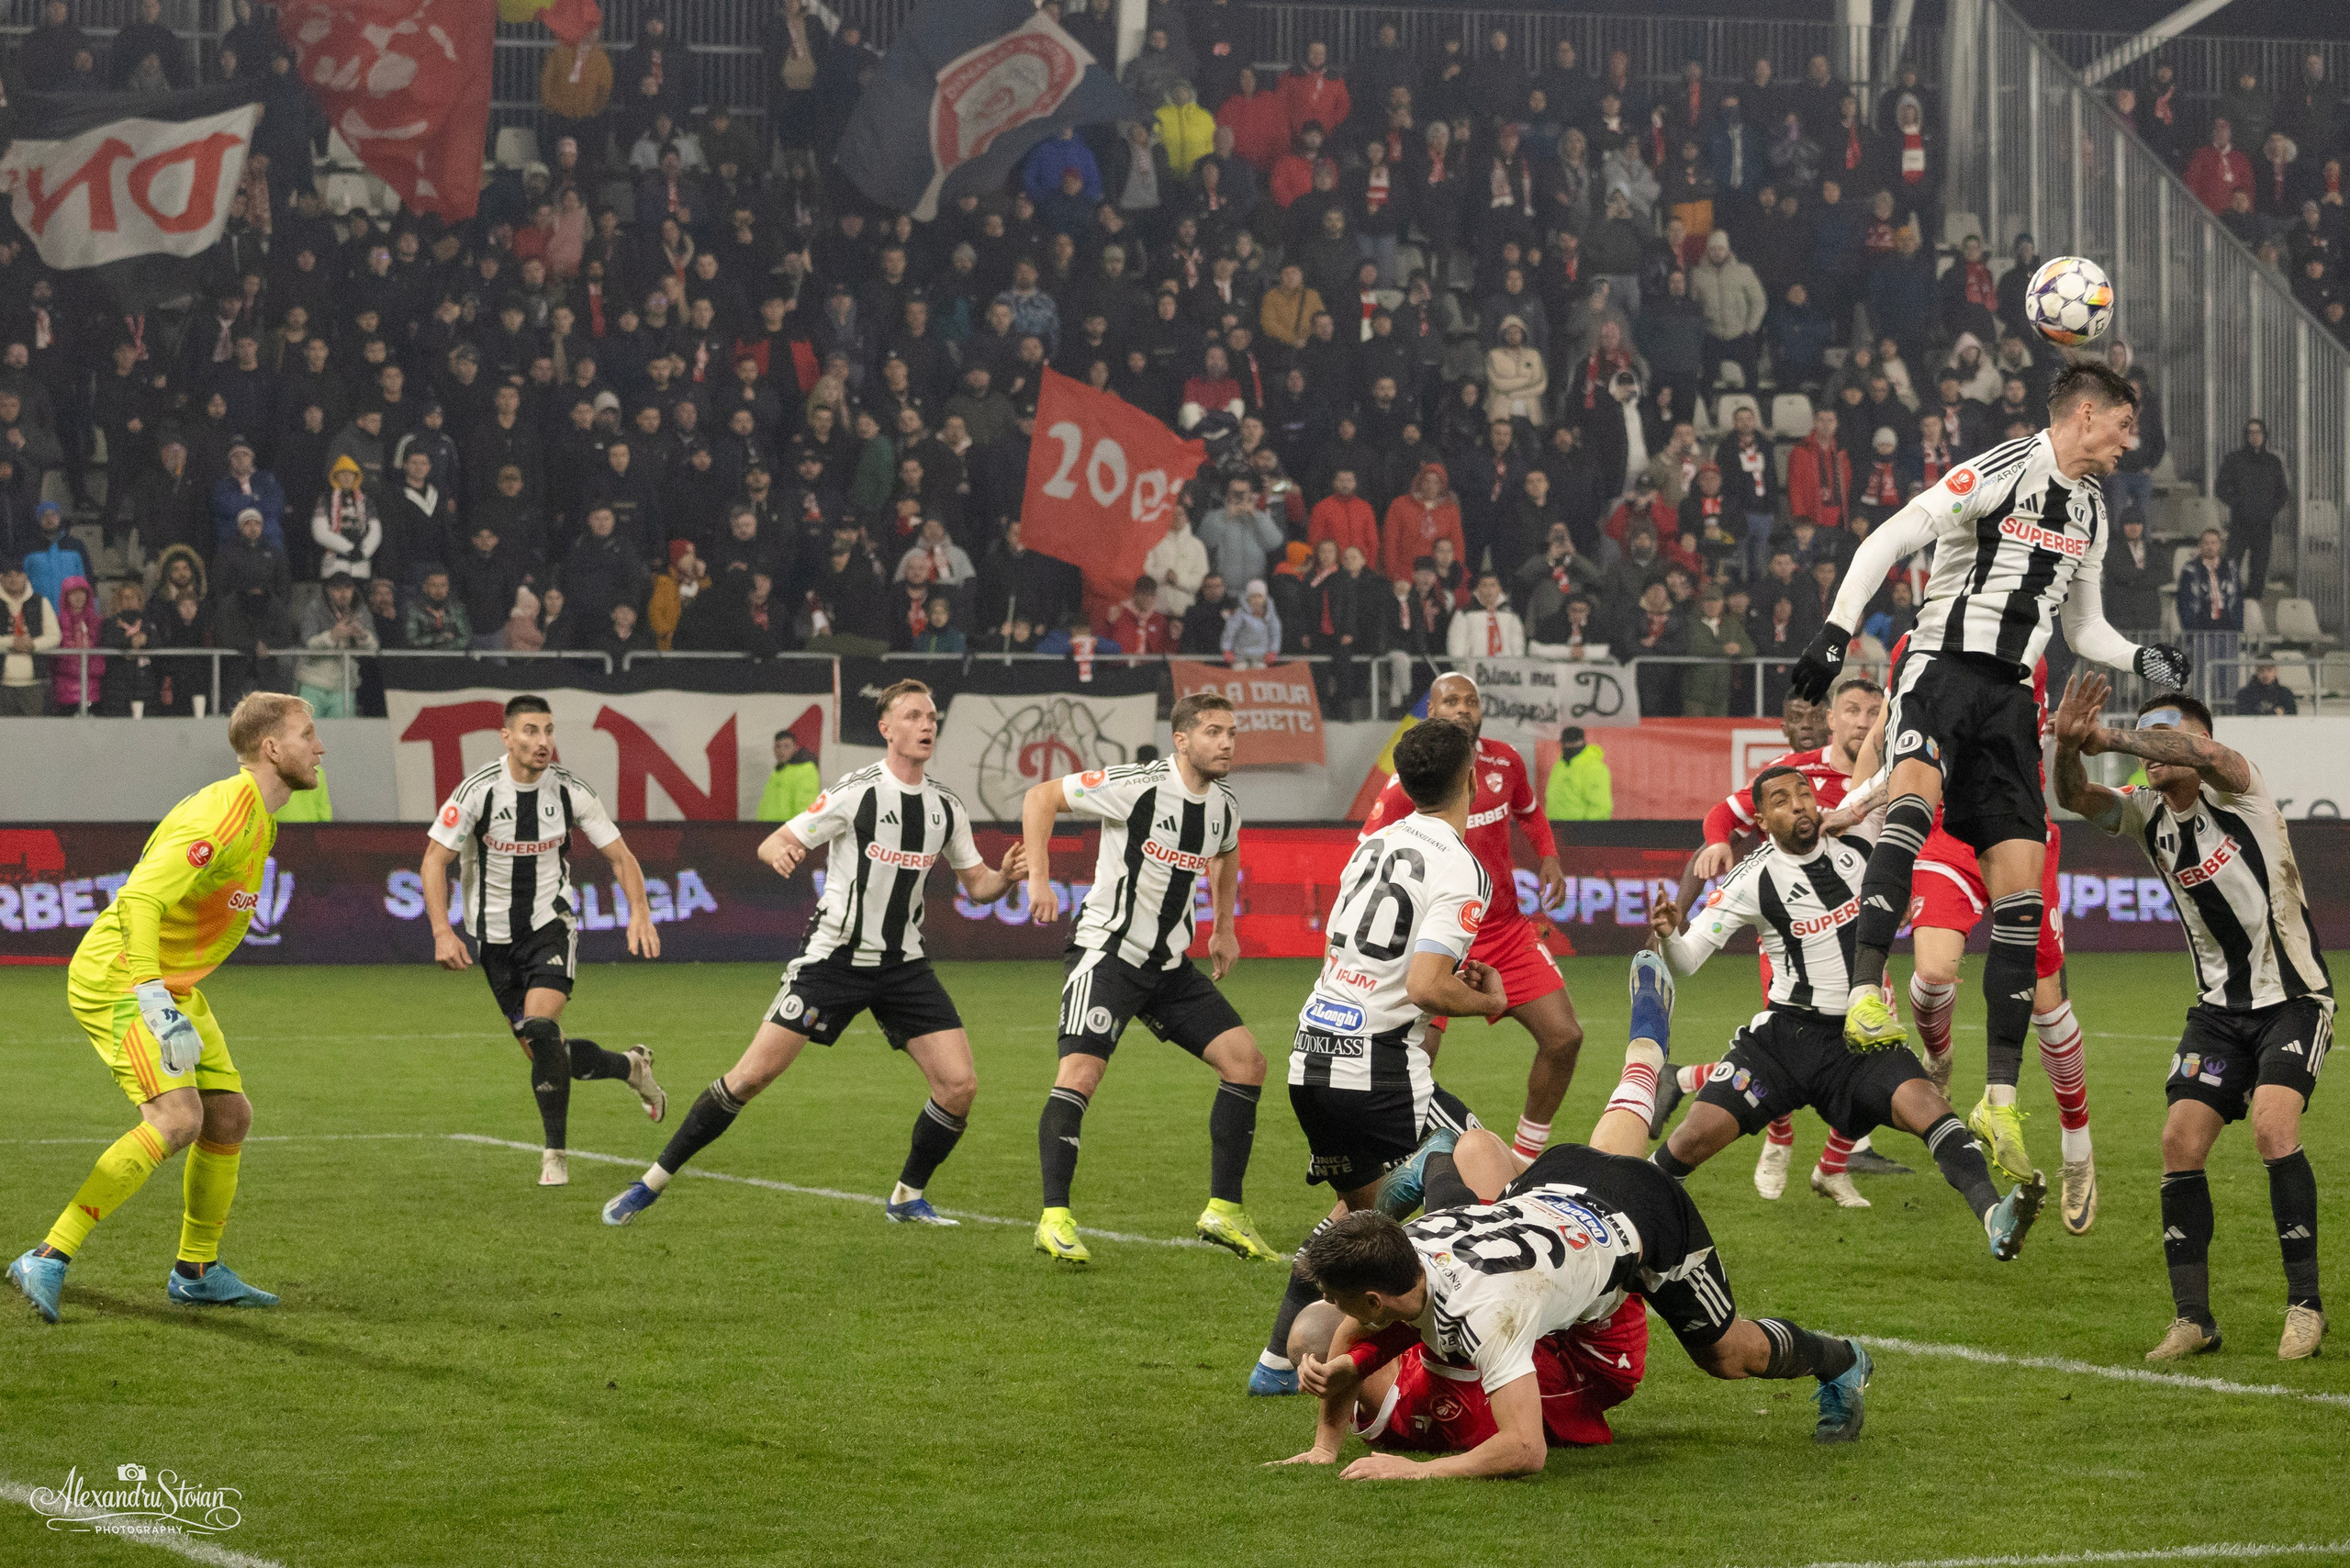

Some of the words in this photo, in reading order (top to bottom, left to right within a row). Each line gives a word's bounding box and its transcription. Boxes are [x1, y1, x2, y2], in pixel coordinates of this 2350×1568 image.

[2001, 517, 2091, 556] SUPERBET
[1123, 773, 1167, 788] AROBS
[1466, 801, 1510, 830] ERBET
[483, 834, 565, 855] SUPERBET
[1402, 824, 1448, 853] TRANSILVANIA
[1331, 838, 1426, 962] 26
[1093, 1014, 1105, 1027] U
[1295, 1035, 1364, 1057] AUTOKLASS
